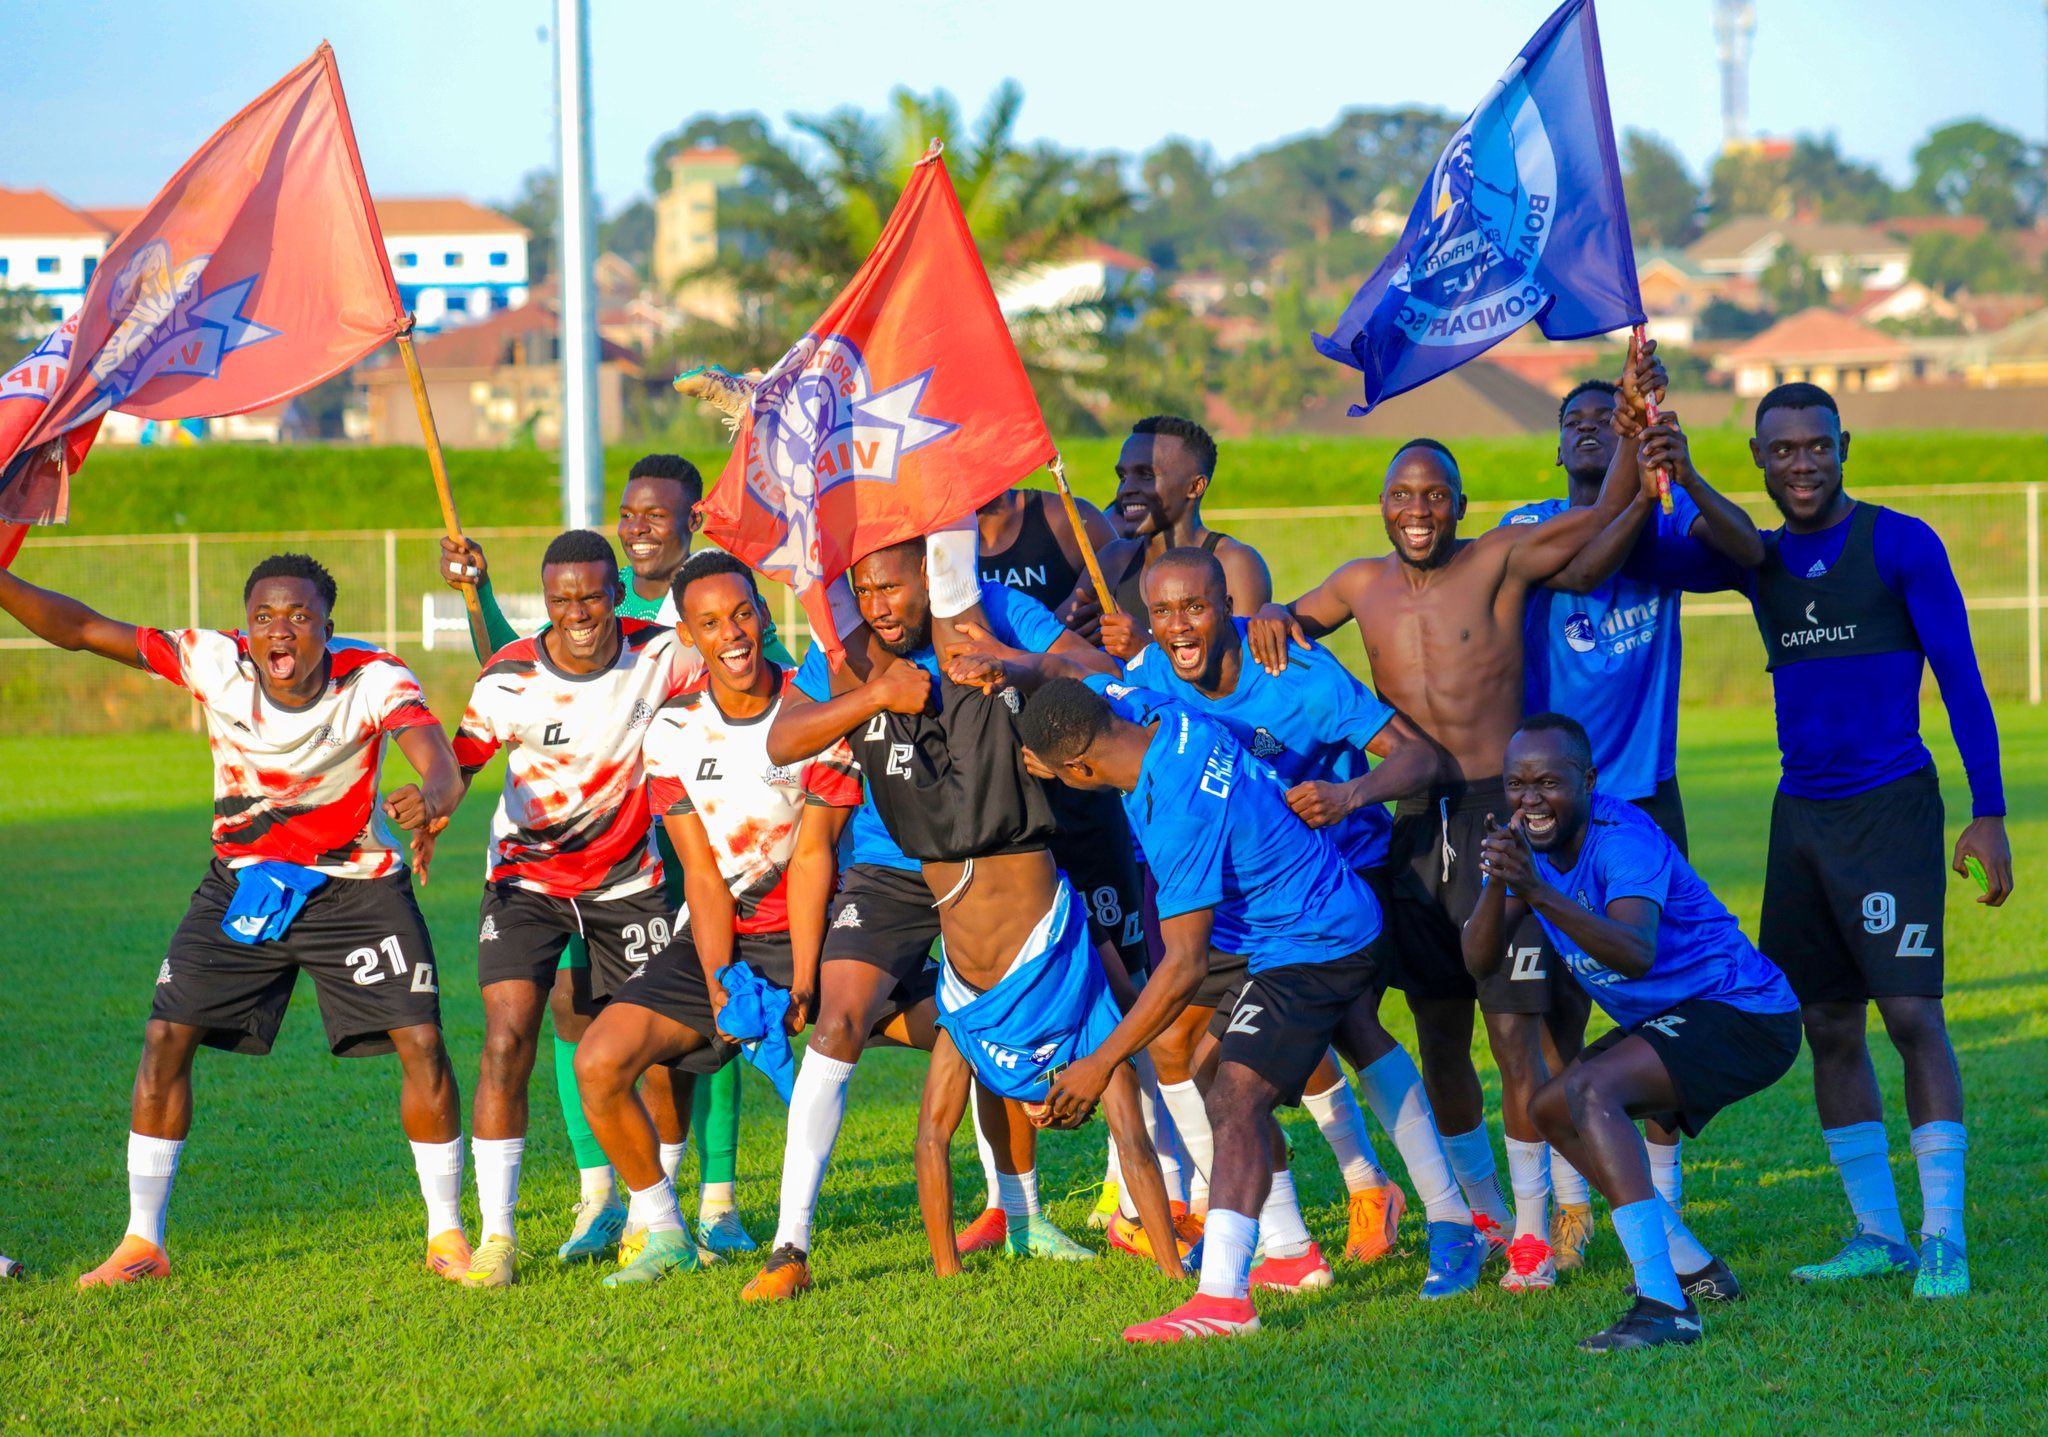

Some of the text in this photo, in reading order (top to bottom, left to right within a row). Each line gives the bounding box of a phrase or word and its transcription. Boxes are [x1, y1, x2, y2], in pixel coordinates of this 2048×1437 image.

[1781, 624, 1857, 647] CATAPULT
[1862, 891, 1896, 934] 9
[345, 934, 408, 986] 21
[621, 916, 671, 962] 29
